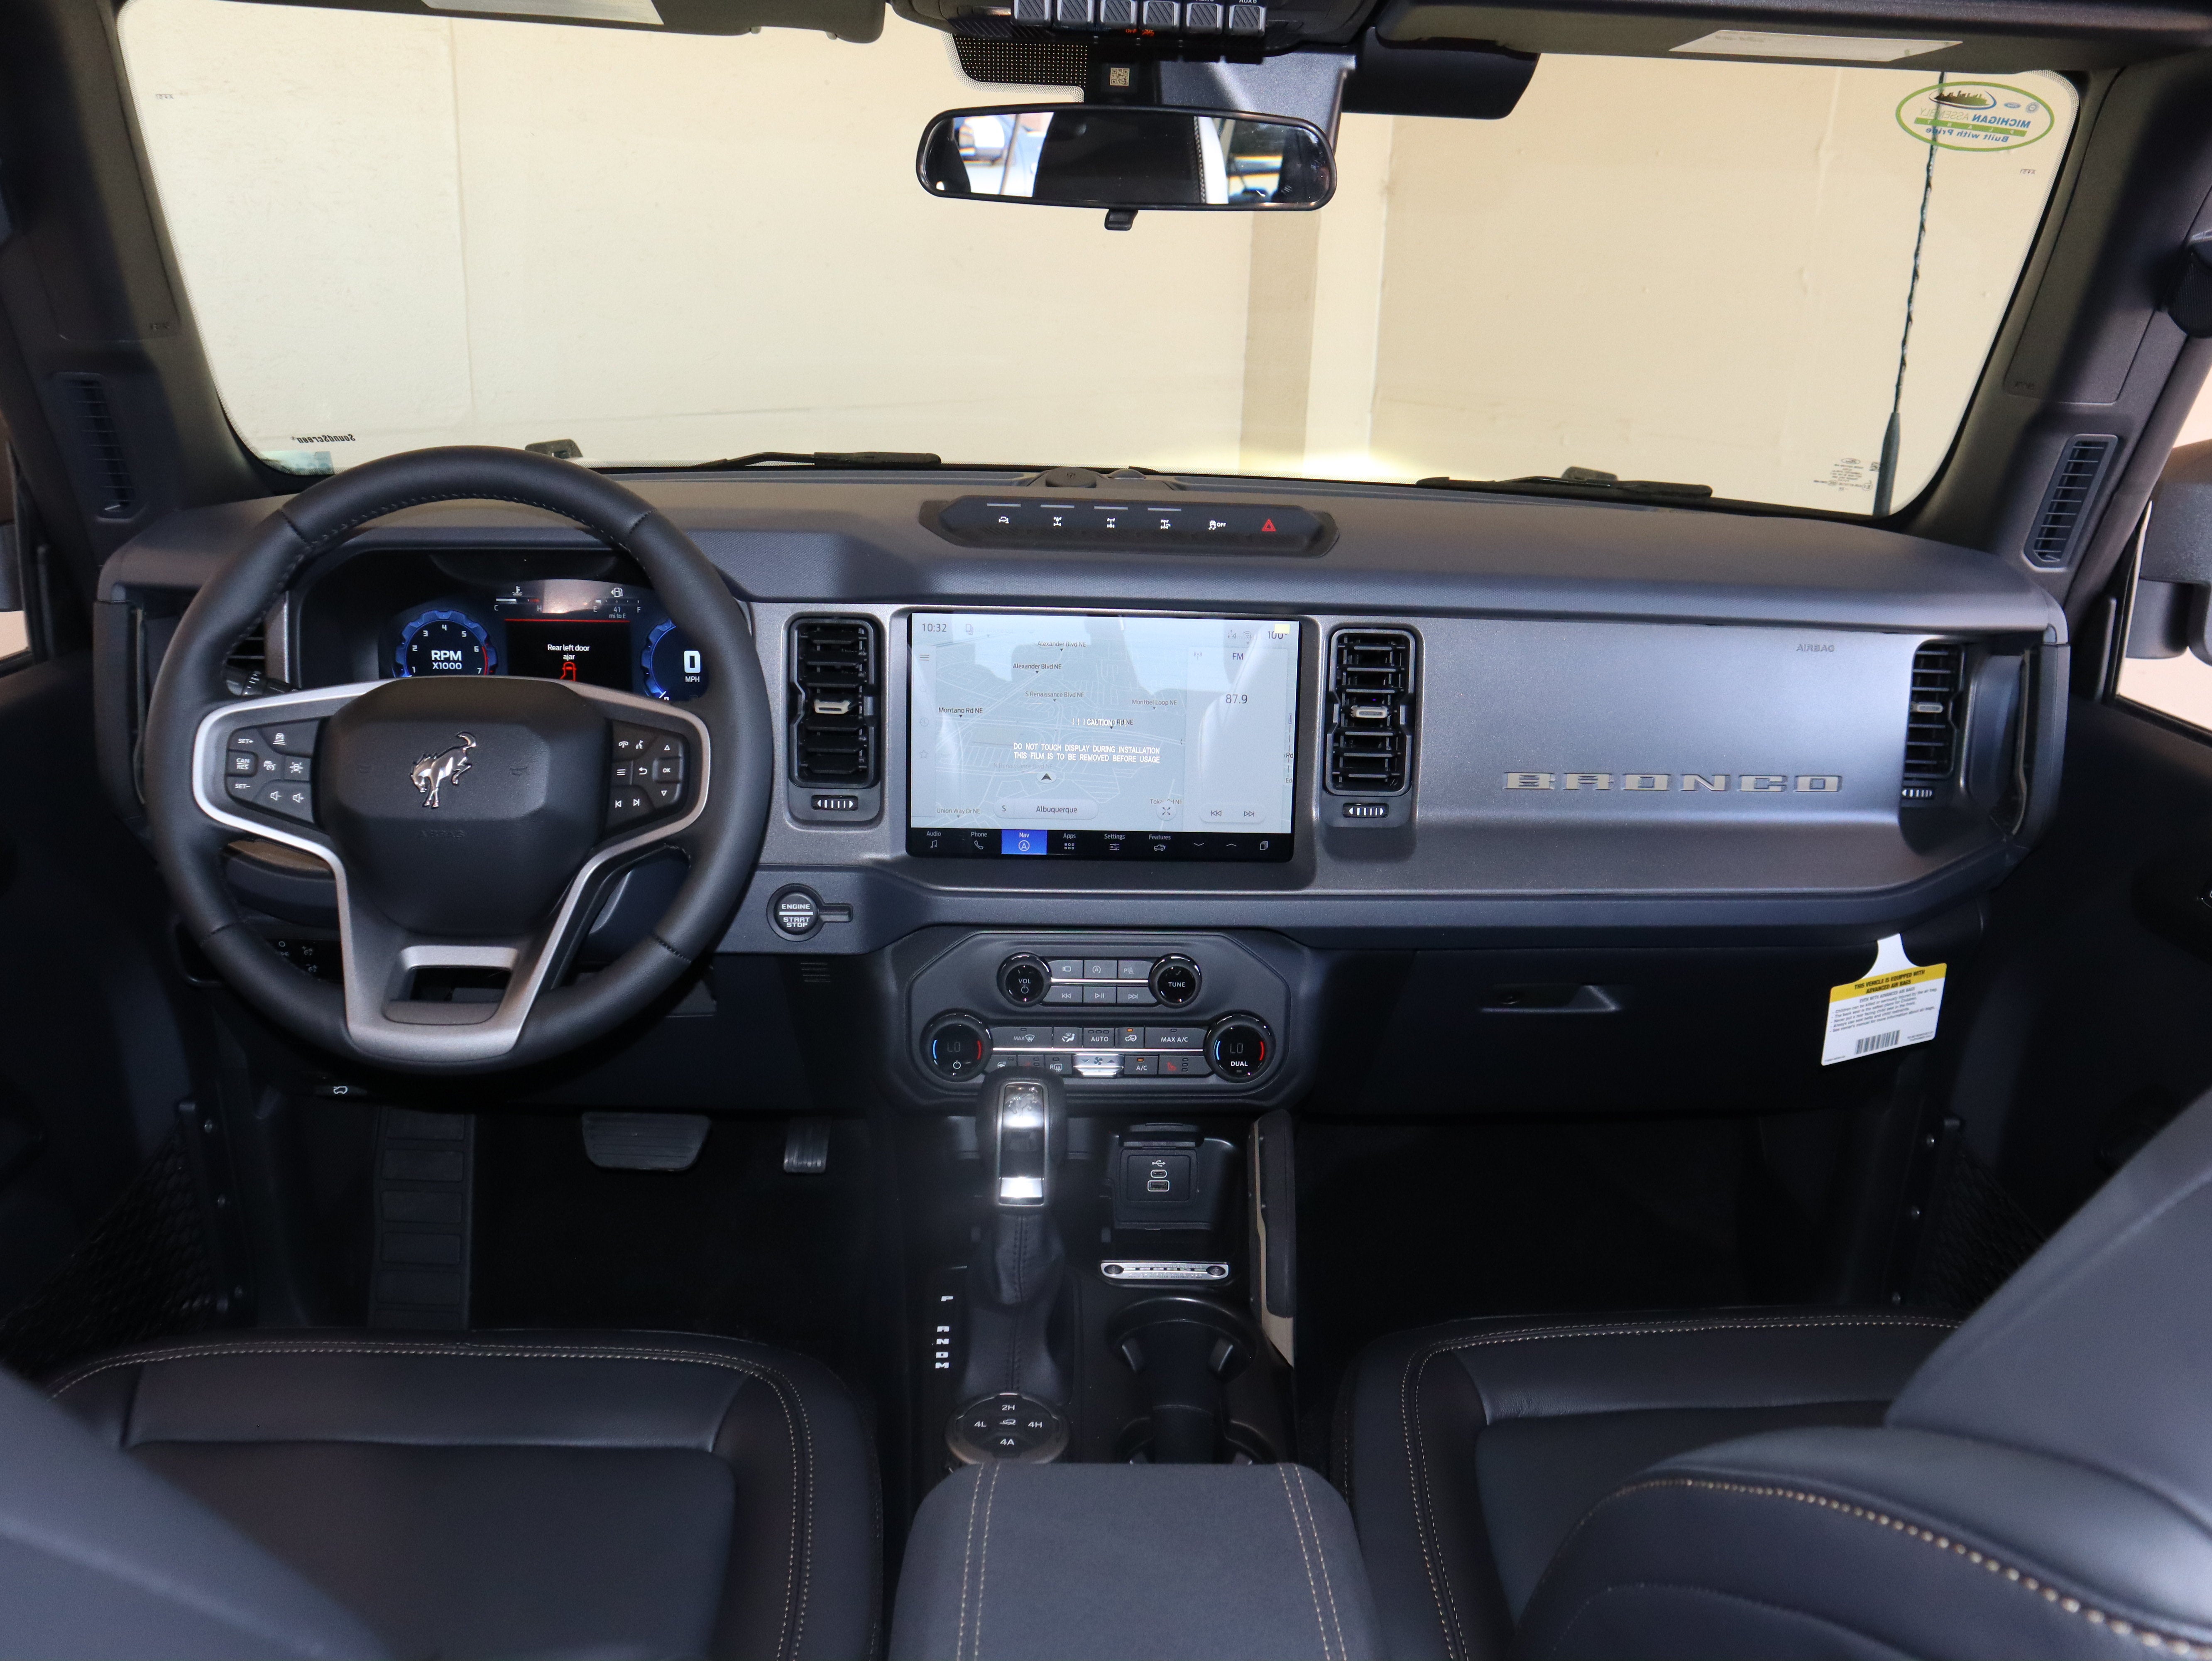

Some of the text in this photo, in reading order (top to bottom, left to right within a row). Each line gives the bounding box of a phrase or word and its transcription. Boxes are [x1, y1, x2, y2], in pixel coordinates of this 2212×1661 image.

[922, 623, 947, 632] 10:32
[1796, 644, 1835, 652] AIRBAG
[431, 650, 462, 661] RPM
[684, 650, 701, 673] 0
[1226, 694, 1248, 703] 87.9
[1118, 746, 1160, 754] INSTALLATION
[1503, 772, 1842, 792] BRONCO
[1036, 806, 1077, 814] Albuquerque
[1866, 978, 1884, 987] VEHICLE
[1891, 973, 1912, 981] EQUIPPED
[1866, 984, 1890, 994] ADVANCED
